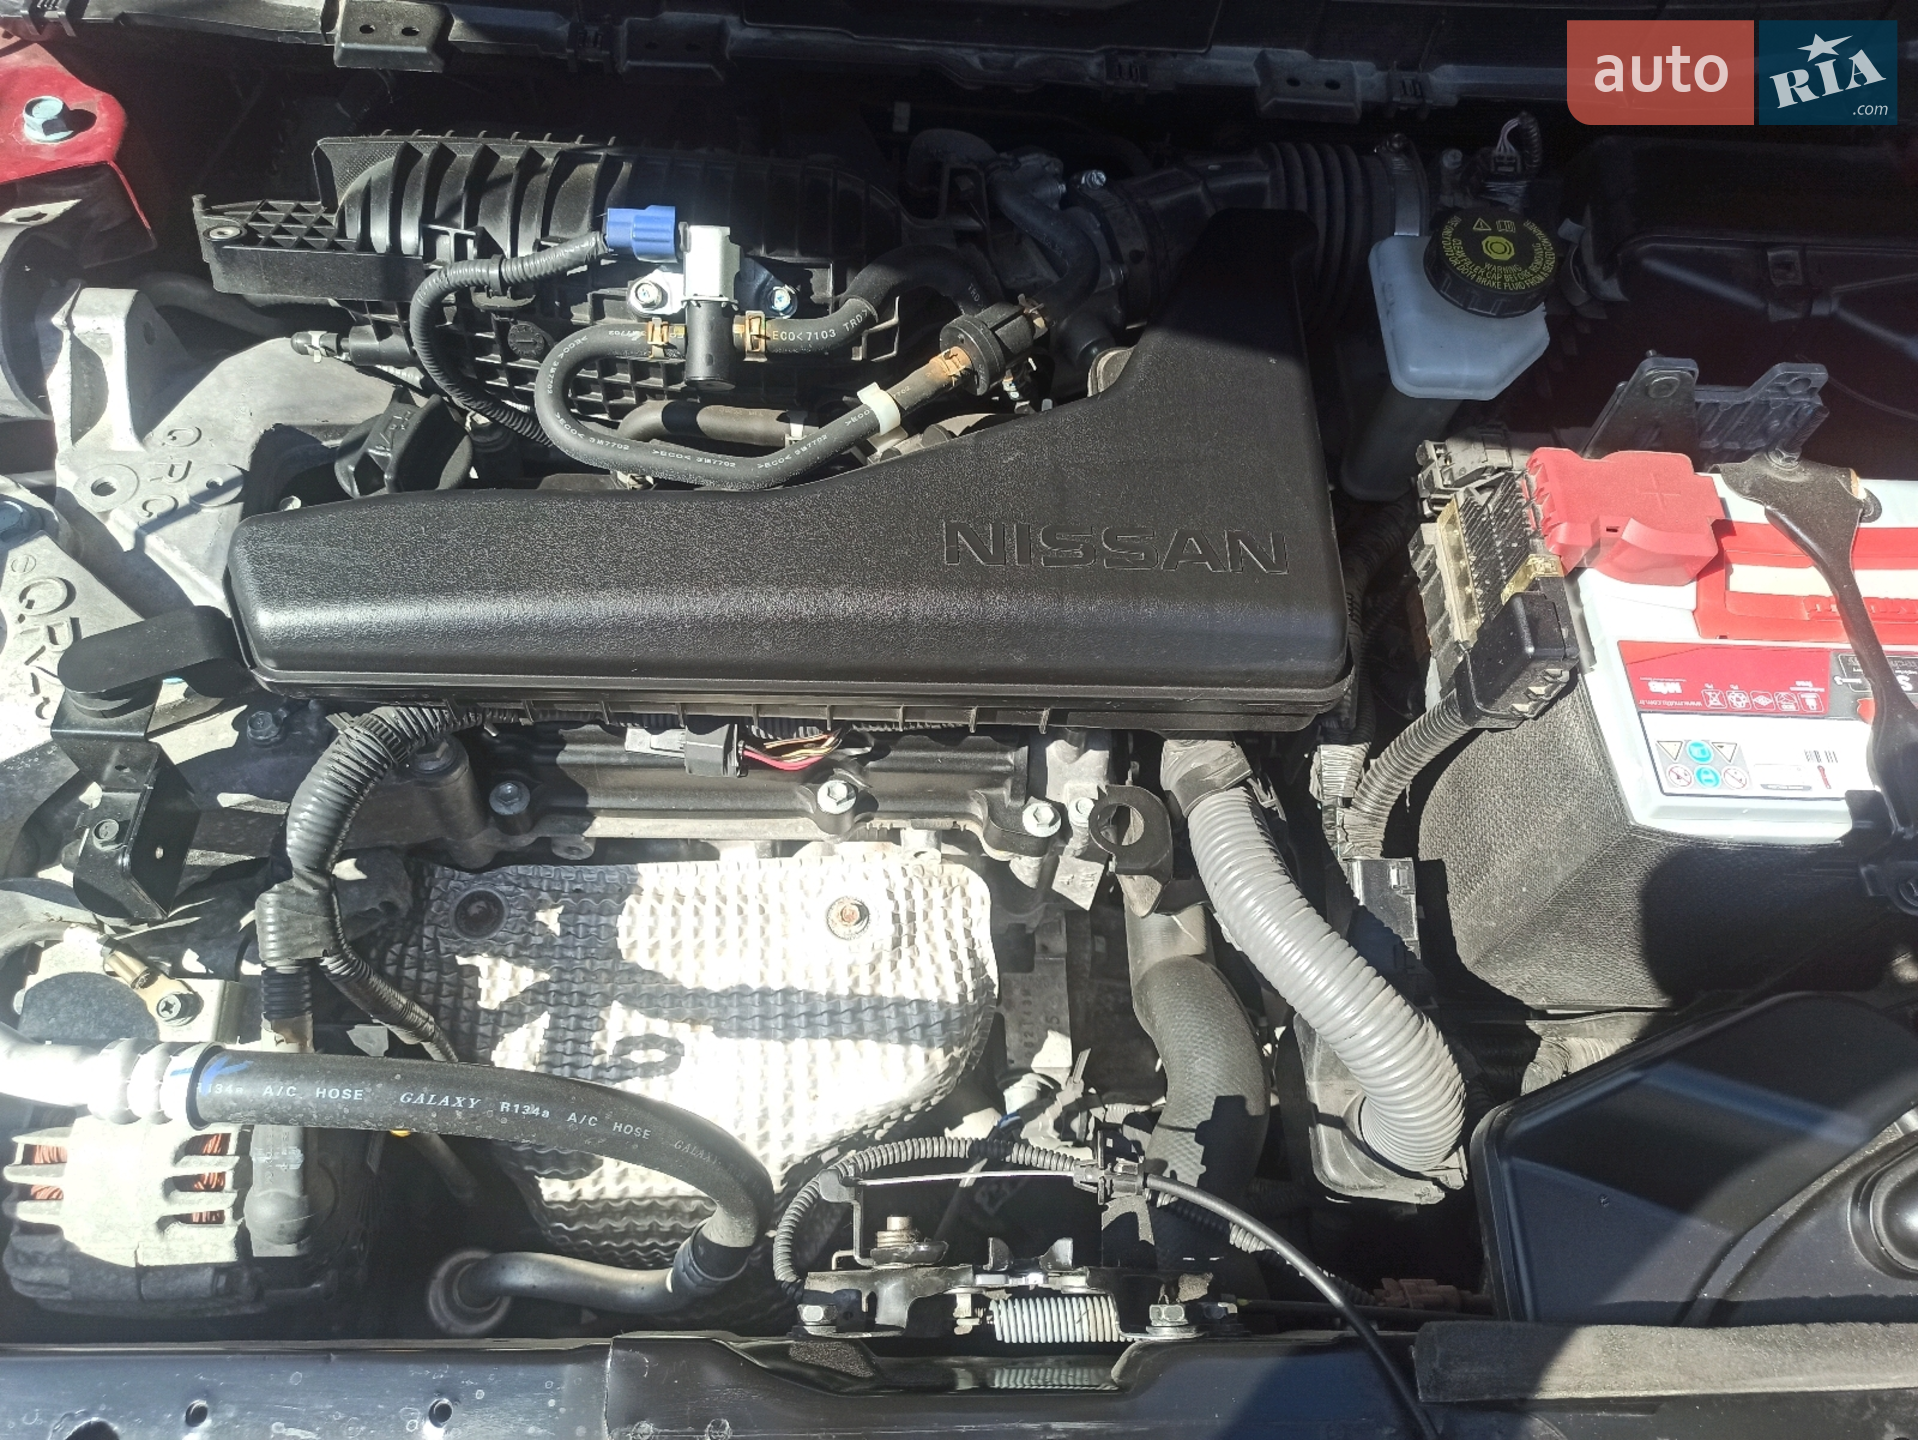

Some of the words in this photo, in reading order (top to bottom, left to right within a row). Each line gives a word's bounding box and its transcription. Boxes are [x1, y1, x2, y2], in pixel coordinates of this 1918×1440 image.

[1462, 257, 1485, 276] FILLER
[1485, 270, 1502, 281] CAP
[1504, 270, 1533, 282] BEFORE
[1484, 262, 1522, 274] WARNING
[1475, 276, 1502, 289] BRAKE
[1503, 281, 1526, 291] FLUID
[1526, 273, 1546, 288] FROM
[943, 519, 1289, 575] NISSAN
[262, 1084, 297, 1098] A/C
[316, 1087, 364, 1101] HOSE
[400, 1091, 482, 1109] GALAXY
[500, 1101, 550, 1118] R134a
[566, 1112, 598, 1128] A/C
[612, 1121, 652, 1141] HOSE
